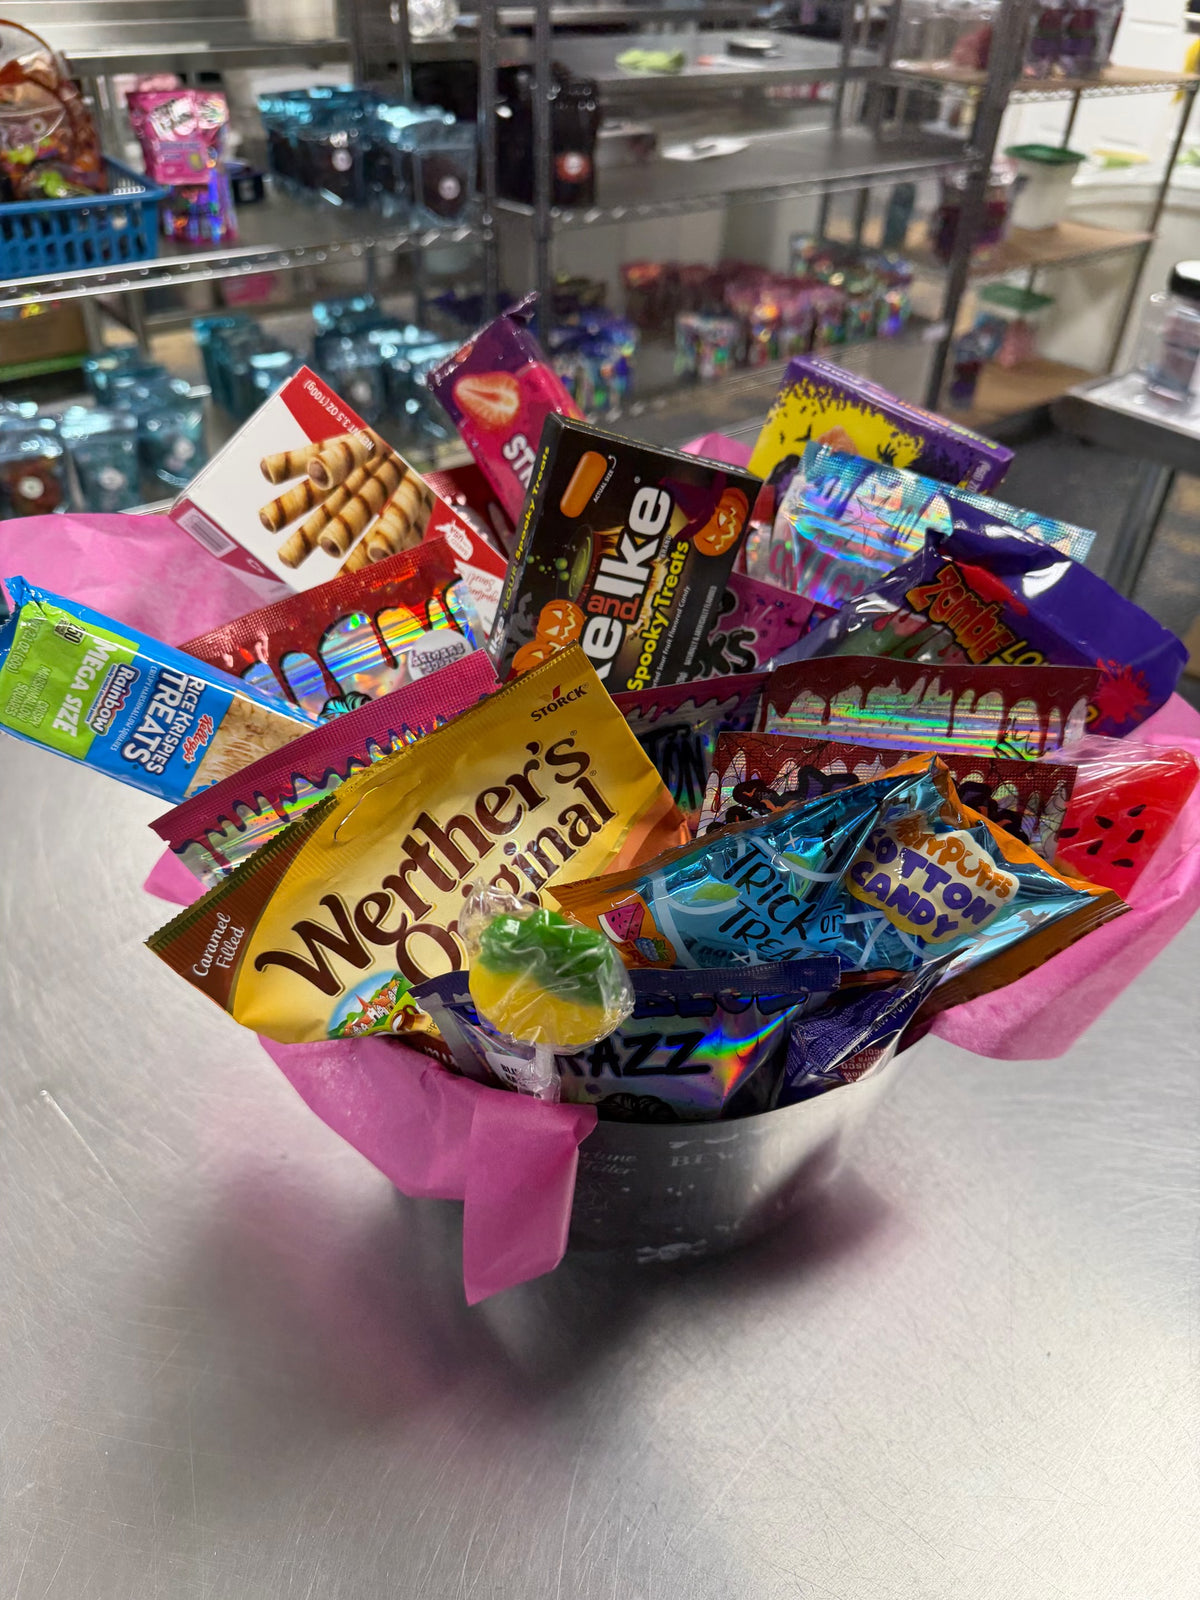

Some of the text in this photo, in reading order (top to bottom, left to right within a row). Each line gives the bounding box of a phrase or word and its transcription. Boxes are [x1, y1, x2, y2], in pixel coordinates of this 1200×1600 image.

[303, 380, 330, 407] (100g)
[325, 402, 339, 416] OZ
[336, 412, 352, 428] 3.5
[515, 498, 535, 560] Spooky
[532, 446, 550, 495] Treats
[593, 469, 614, 503] ACTUAL SIZE
[63, 624, 86, 644] 250
[587, 595, 640, 621] and
[627, 541, 690, 691] Spooky Treats
[668, 608, 683, 639] Flavored
[678, 585, 692, 608] Candy
[6, 652, 25, 675] (60g)
[18, 641, 31, 653] OZ
[5, 683, 29, 717] SQUARES
[17, 665, 52, 723] MARSHMALLOW
[31, 700, 50, 728] CRISPY
[52, 638, 119, 737] MEGA SIZE
[92, 666, 136, 732] Rainbow
[110, 665, 158, 752] CRISPY MARSHMALLOW SQUARES
[530, 684, 588, 722] STORCK
[124, 671, 189, 764] TREATS
[146, 675, 205, 774] RICE KRISPIES
[182, 714, 214, 763] Kellogg's
[254, 738, 591, 997] Werther's
[723, 842, 844, 940] TRICK or
[863, 828, 996, 925] COTTON
[851, 861, 959, 938] CANDY
[192, 911, 231, 976] Caramel
[215, 926, 245, 969] Filled
